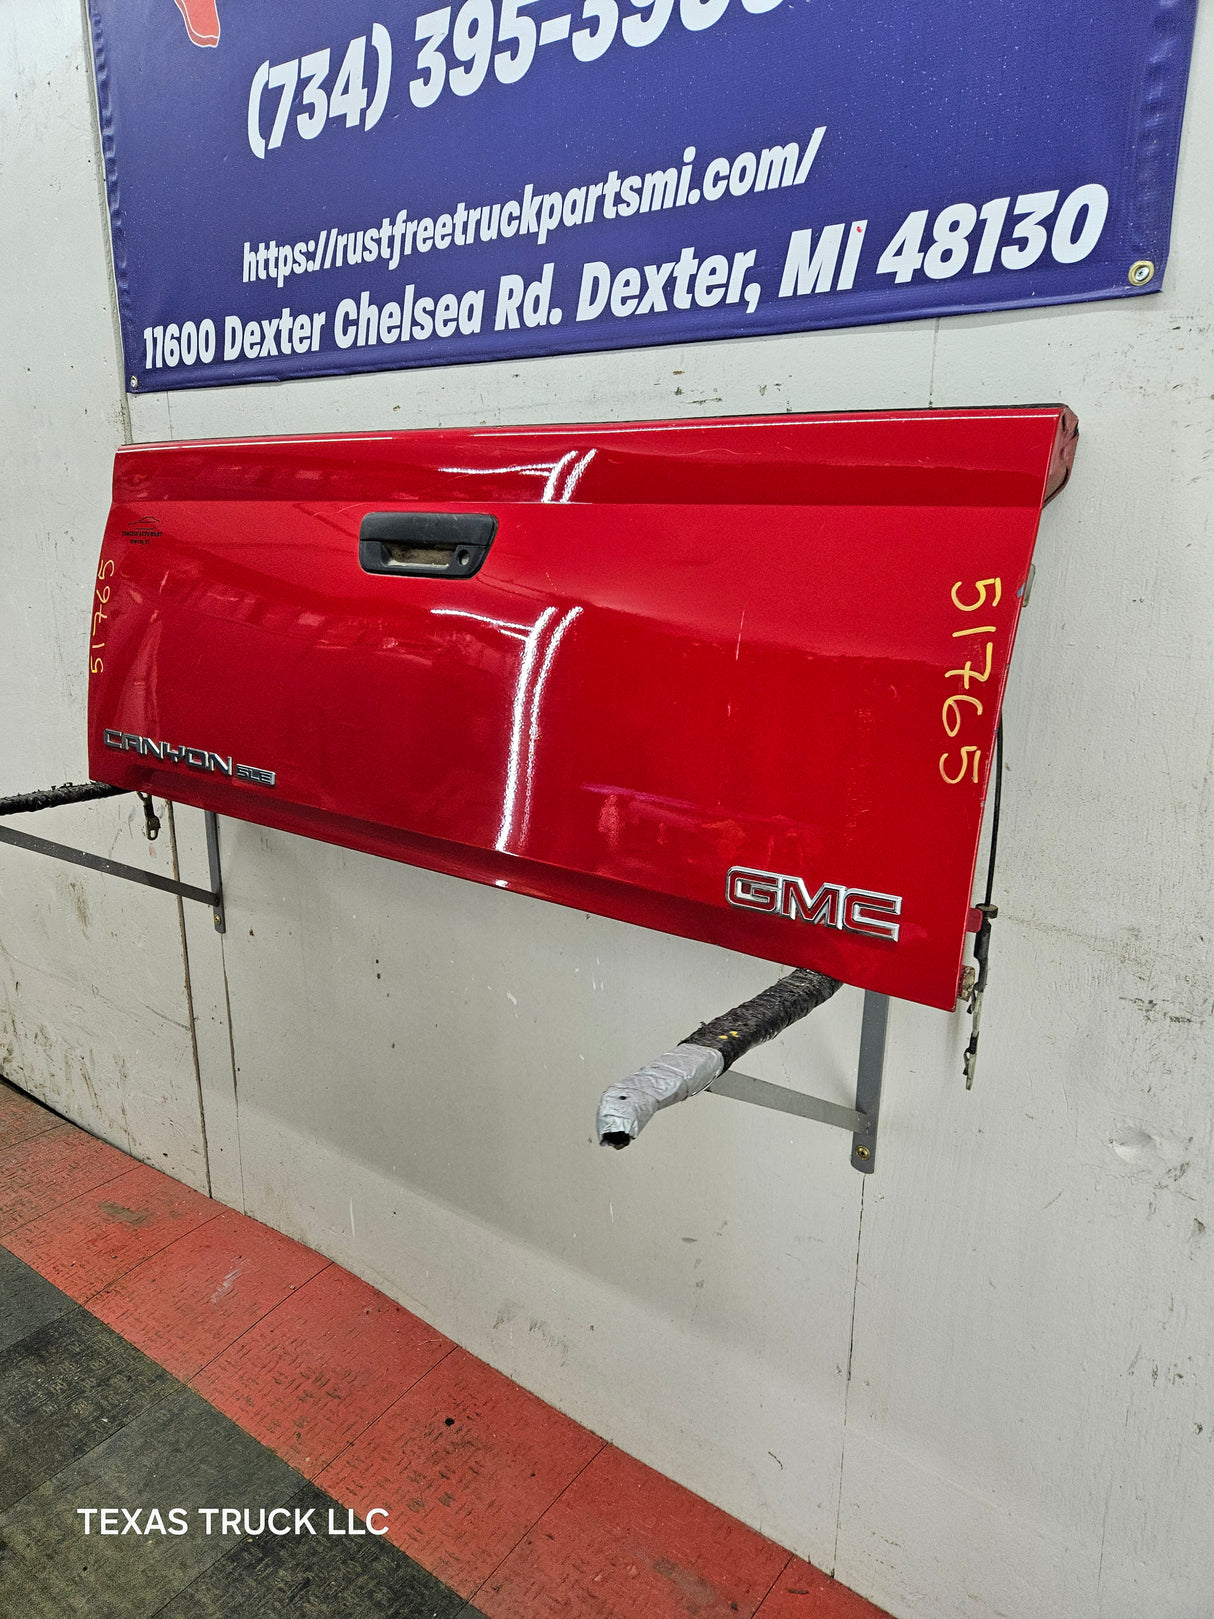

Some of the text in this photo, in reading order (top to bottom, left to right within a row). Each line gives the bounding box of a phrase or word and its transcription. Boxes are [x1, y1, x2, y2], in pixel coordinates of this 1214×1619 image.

[248, 23, 392, 160] (734)
[243, 126, 827, 288] https://rustfreetruckpartsmi.com/
[143, 184, 1110, 370] 11600 Dexter Chelsea Rd. Dexter, MI 48130
[91, 559, 115, 674] 51765
[938, 577, 1001, 785] 51765
[103, 728, 276, 786] CANYON SLE
[725, 865, 903, 943] GMC
